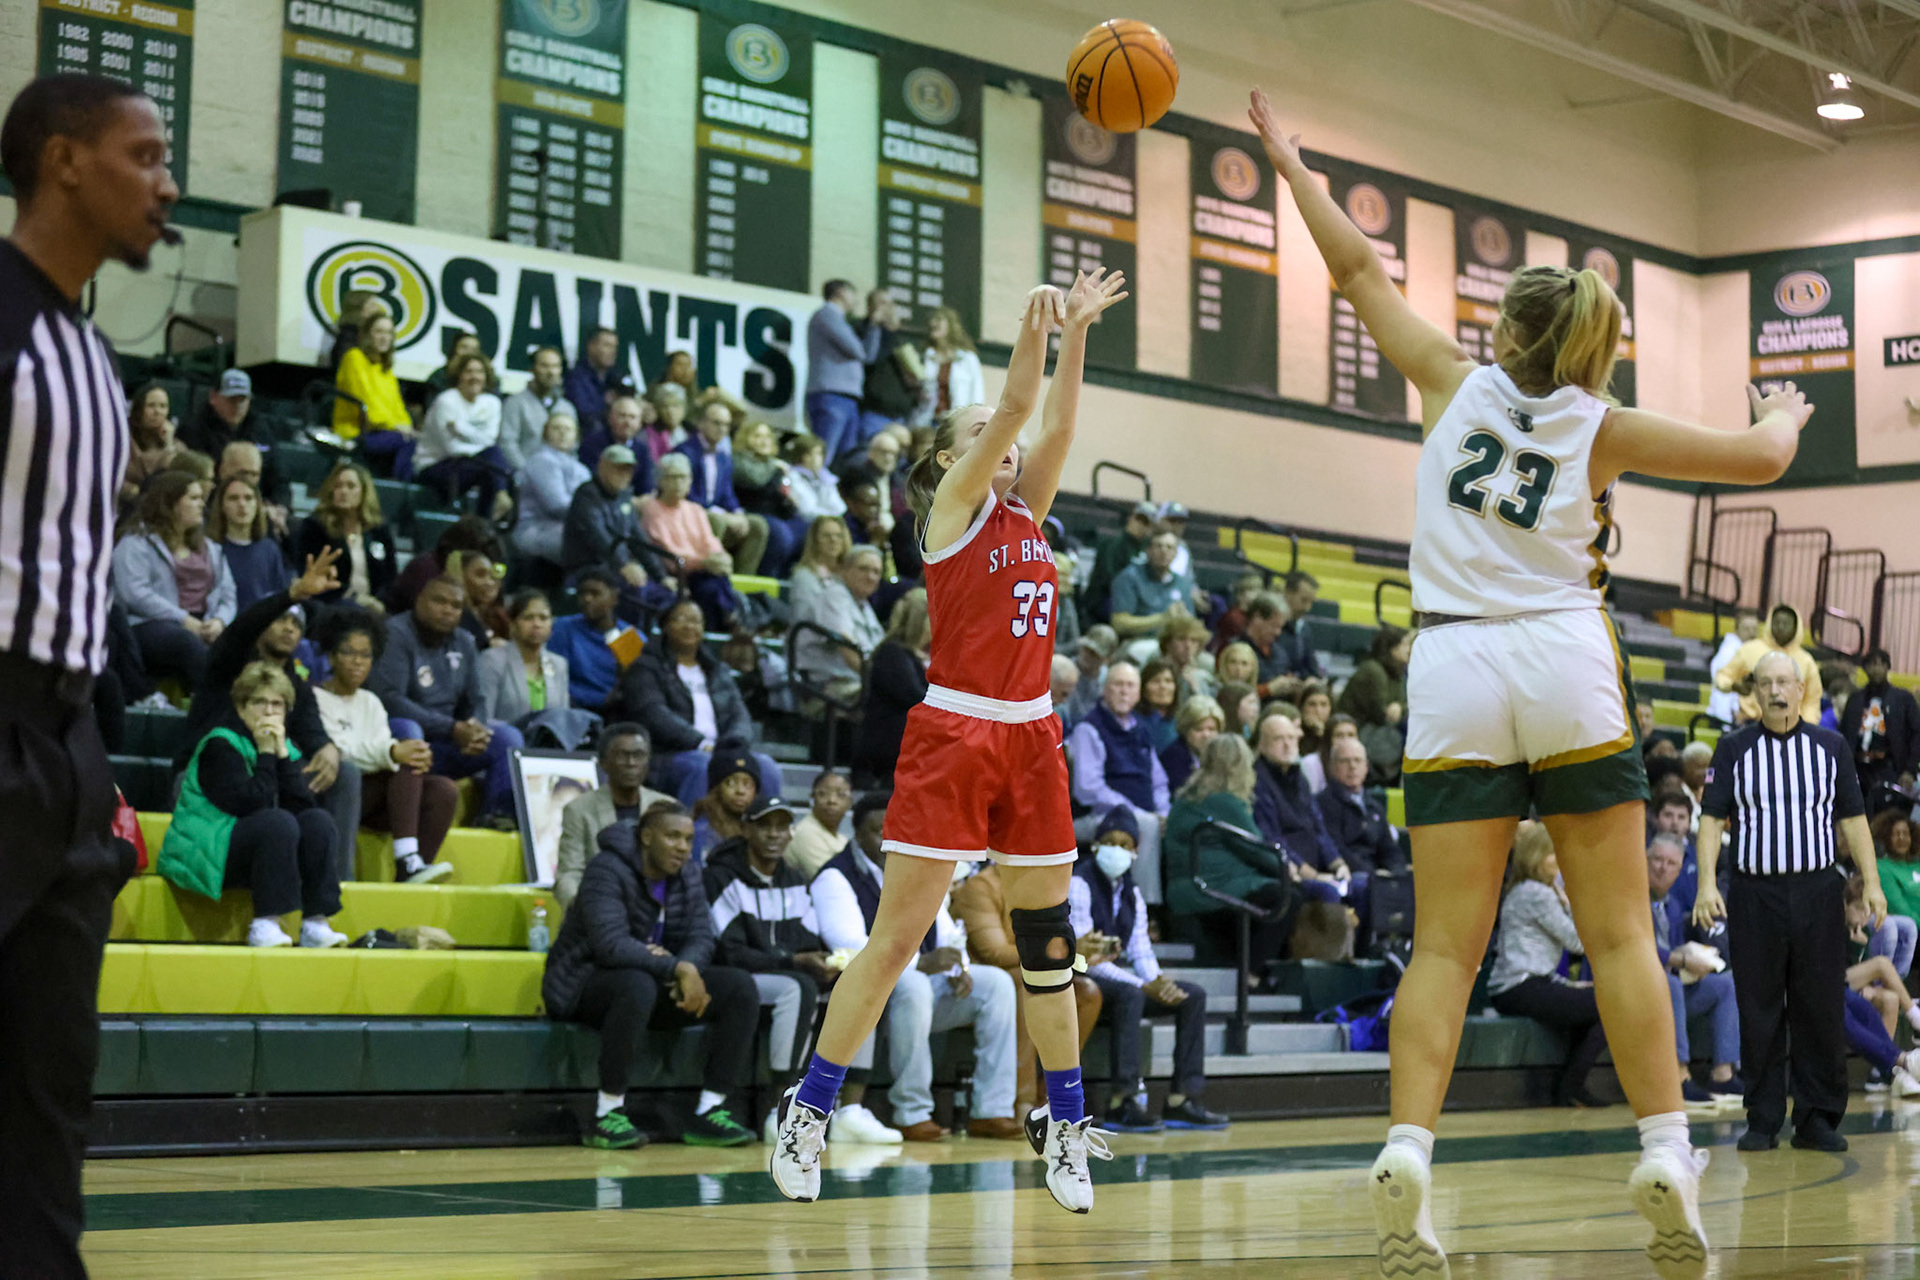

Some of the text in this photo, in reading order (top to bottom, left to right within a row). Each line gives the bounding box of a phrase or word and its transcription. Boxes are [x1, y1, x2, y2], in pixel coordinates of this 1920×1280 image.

[289, 1, 415, 49] CHAMPIONS
[505, 47, 620, 96] CHAMPIONS
[703, 93, 809, 139] CHAMPIONS
[882, 134, 978, 178] CHAMPIONS
[440, 256, 794, 410] SAINTS
[1757, 327, 1849, 355] CHAMPIONS
[1446, 428, 1560, 533] 23
[988, 544, 1015, 575] ST.
[1010, 580, 1055, 638] 33
